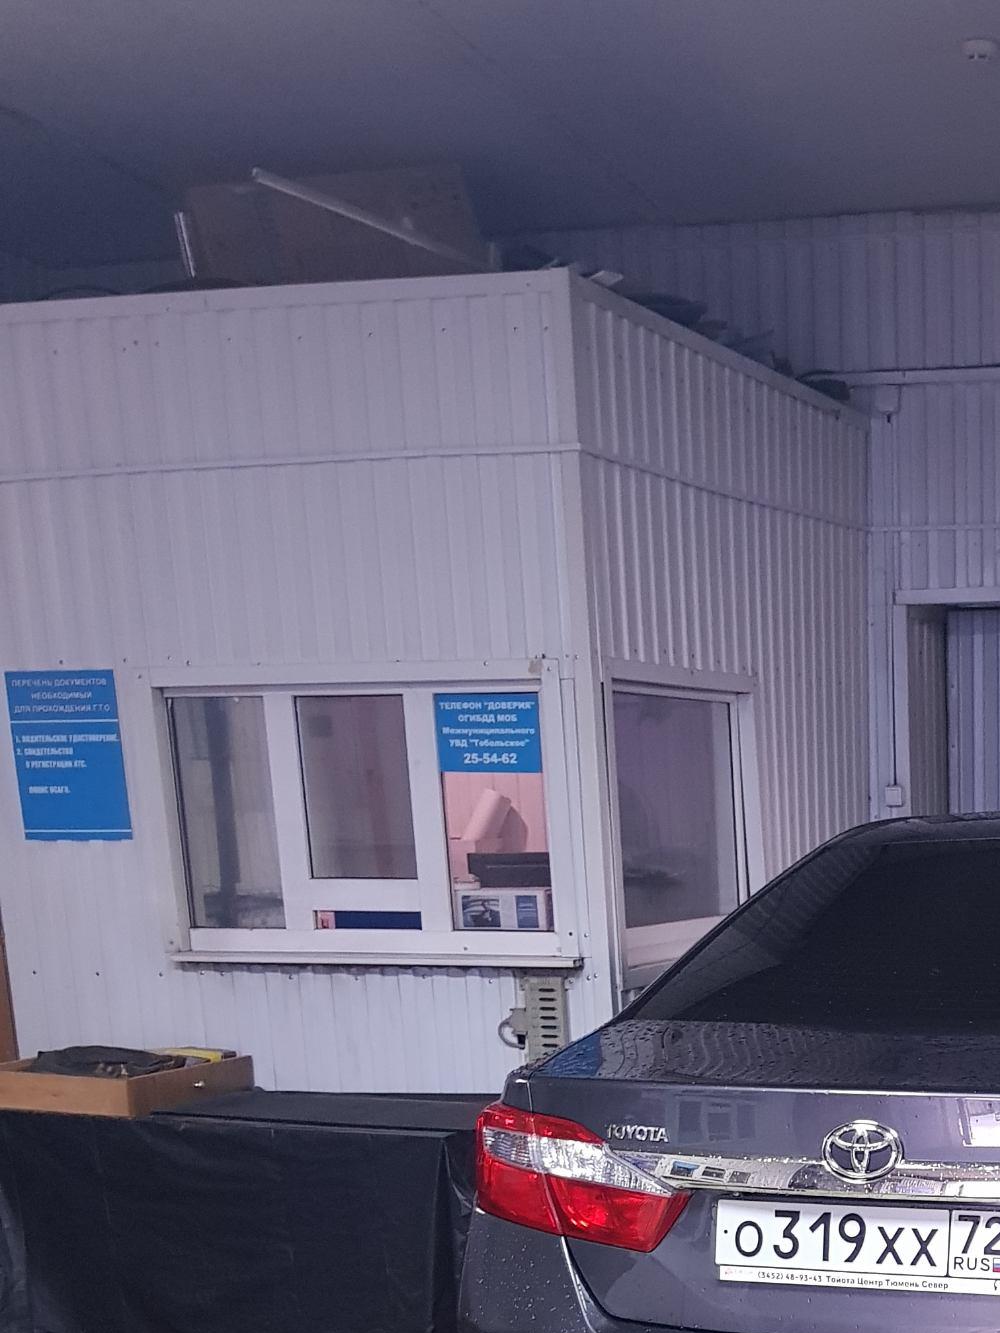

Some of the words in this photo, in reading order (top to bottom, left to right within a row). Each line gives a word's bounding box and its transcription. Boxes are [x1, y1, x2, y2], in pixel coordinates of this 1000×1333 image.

[54, 678, 107, 687] ДОКУМЕНТОВ
[14, 705, 31, 714] ДЛЯ
[439, 702, 482, 710] ТЕЛЕФОН
[484, 701, 535, 711] "ДОВЕРИЯ"
[457, 714, 496, 723] ОГИБДД
[497, 714, 518, 722] МОБ
[449, 739, 468, 748] УВД
[463, 753, 518, 764] 25-54-62
[604, 1124, 669, 1143] TOYOTA
[953, 1257, 991, 1272] RUS
[757, 1271, 784, 1280] (3452)
[786, 1273, 822, 1283] 48-93-43
[857, 1276, 884, 1287] Центр
[886, 1279, 920, 1288] Тюмень
[922, 1281, 949, 1290] Север
